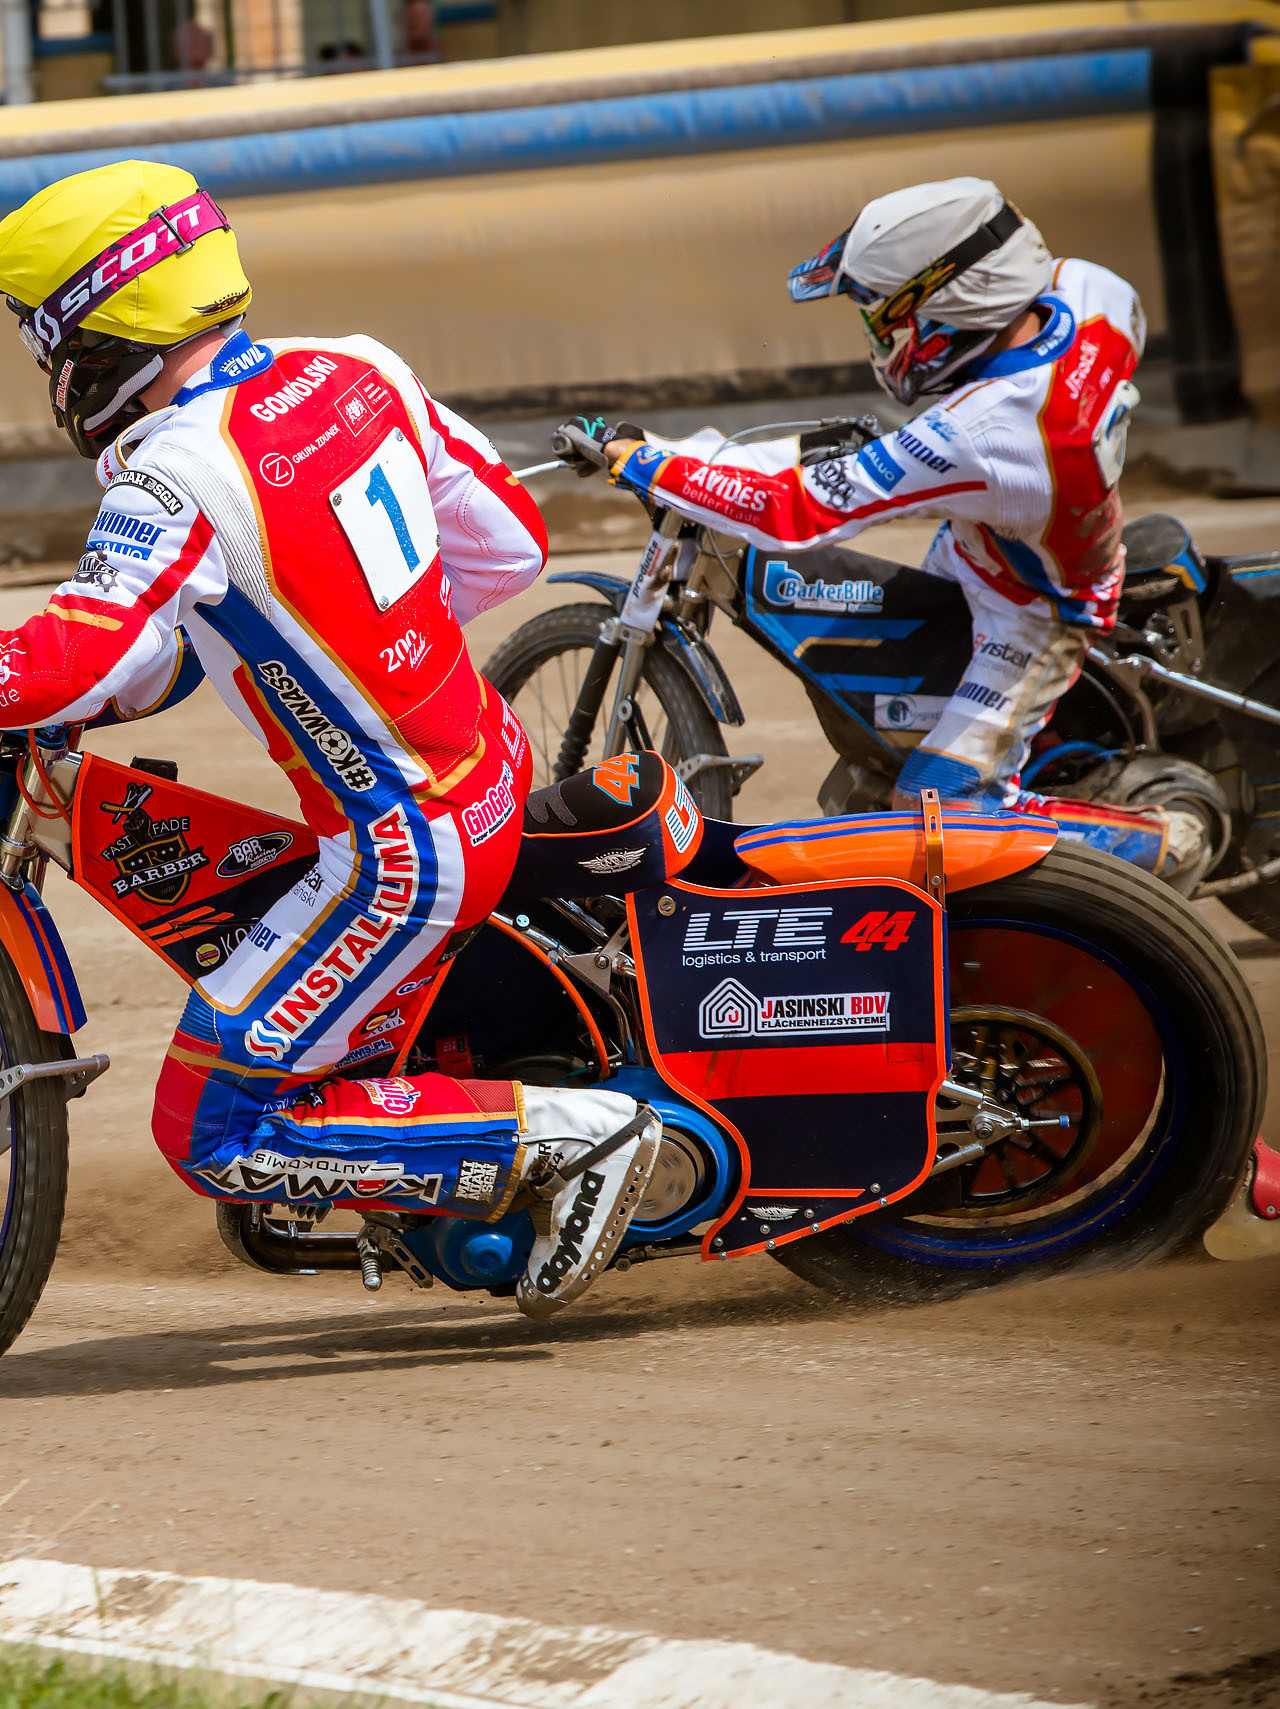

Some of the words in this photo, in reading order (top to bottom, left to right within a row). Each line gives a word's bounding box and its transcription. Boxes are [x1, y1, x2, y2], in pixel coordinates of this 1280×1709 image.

[61, 204, 200, 323] SCOTT
[292, 445, 318, 465] GRUPA
[316, 423, 340, 451] ZDUNEK
[687, 466, 768, 513] AVIDES
[365, 463, 420, 573] 1
[784, 579, 884, 604] BarkerBille
[593, 752, 640, 807] 44
[103, 834, 134, 861] FAST
[151, 817, 190, 836] FADE
[232, 838, 263, 864] BAR
[244, 847, 277, 866] Racing
[112, 852, 208, 895] BARBER
[682, 906, 834, 952] LTE
[839, 910, 917, 952] 44
[681, 951, 741, 969] logistics
[744, 951, 756, 964] &
[759, 948, 827, 965] transport
[761, 996, 845, 1020] JASINSKI
[850, 995, 887, 1015] BDV
[761, 1015, 887, 1030] FLÄCHENHEIZSYSTEME
[255, 1152, 371, 1174] AUTOKOMIS
[535, 1169, 607, 1295] daytona
